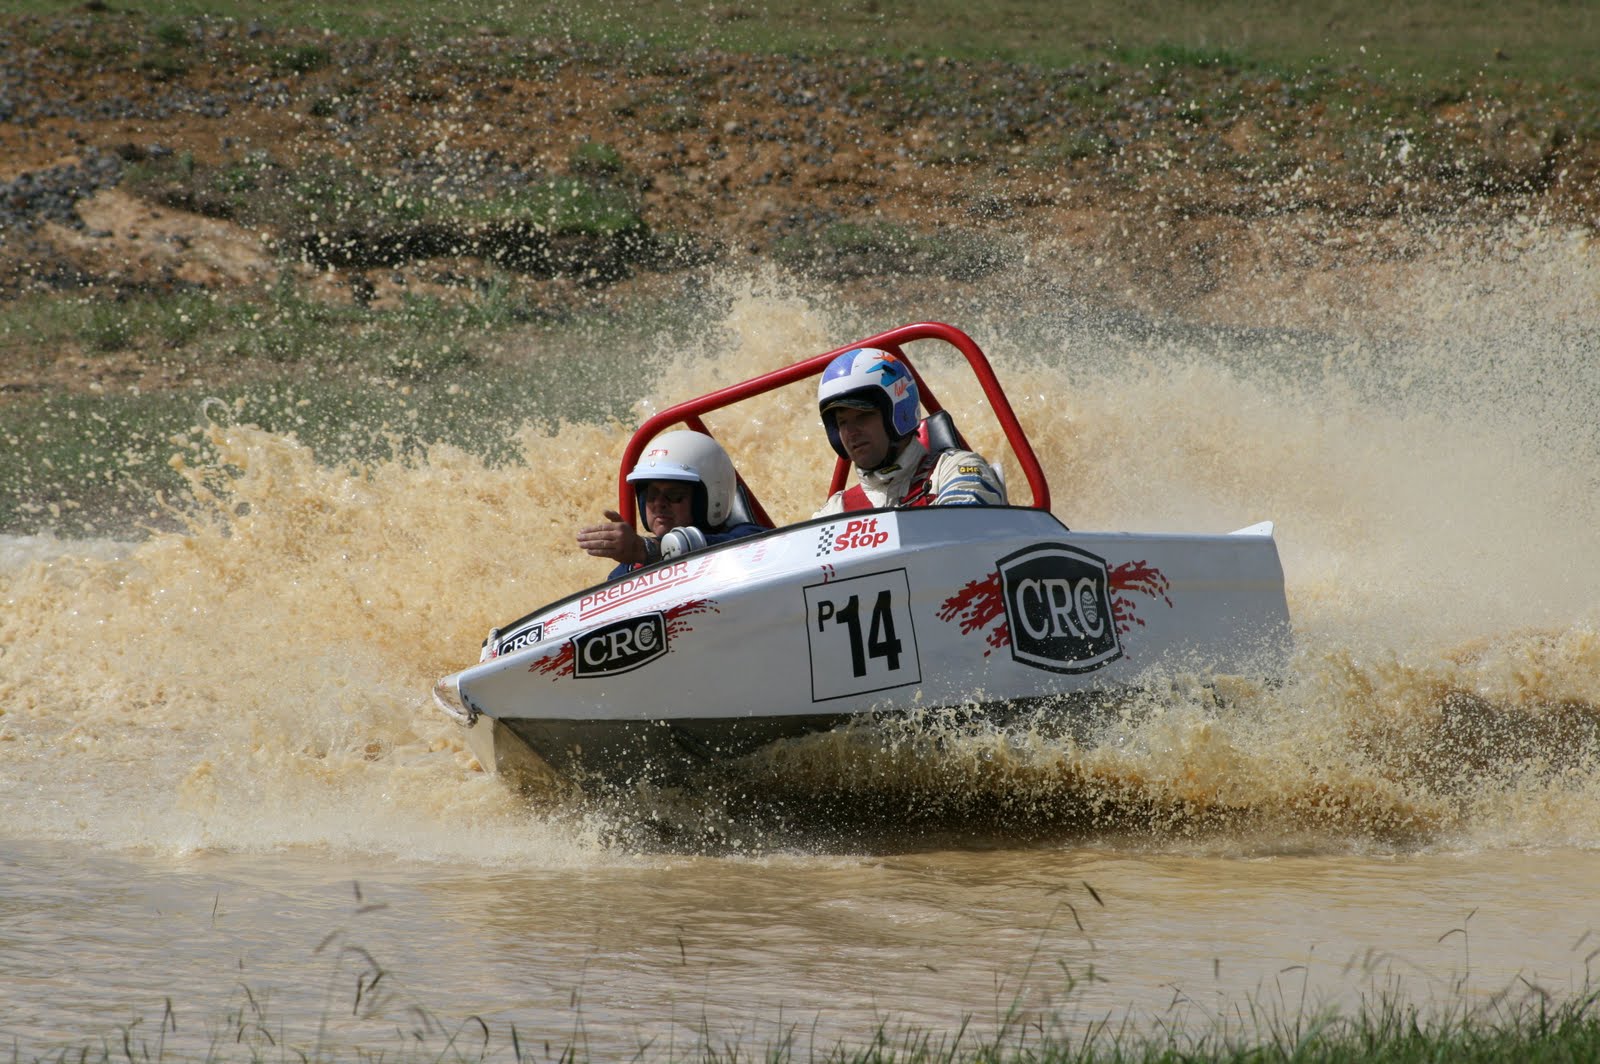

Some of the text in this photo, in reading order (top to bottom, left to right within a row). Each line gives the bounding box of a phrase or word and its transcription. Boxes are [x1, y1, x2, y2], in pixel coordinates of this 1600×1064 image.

[834, 531, 888, 551] Stop
[846, 518, 878, 538] Pit
[580, 561, 688, 611] PREDATOR
[1016, 577, 1104, 640] CRC
[502, 629, 539, 655] CRC
[584, 621, 658, 666] CRC
